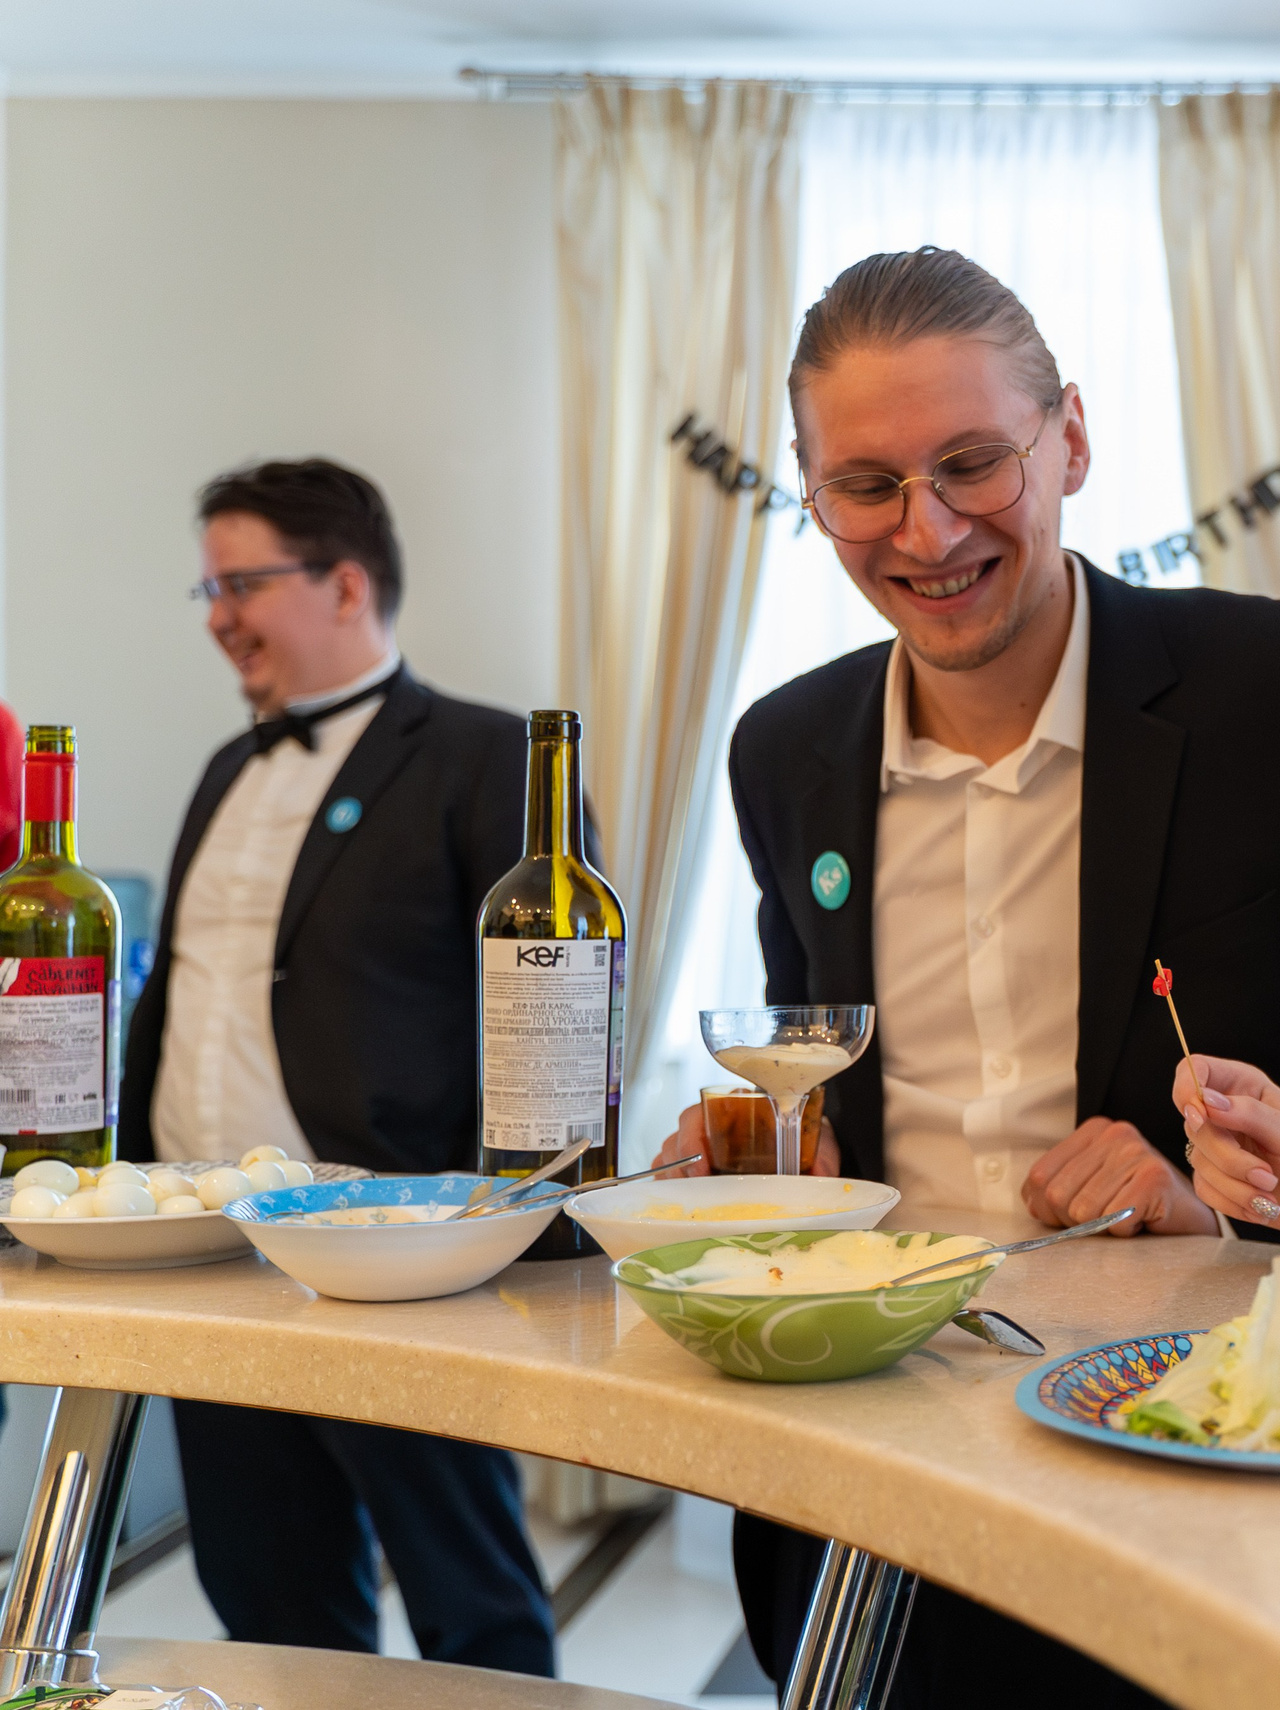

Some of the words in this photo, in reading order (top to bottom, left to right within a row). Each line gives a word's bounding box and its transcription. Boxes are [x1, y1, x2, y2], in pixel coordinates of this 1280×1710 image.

[512, 1002, 529, 1010] КЕФ
[529, 1001, 546, 1010] БАЙ
[548, 1002, 575, 1010] КАРАС
[502, 1008, 556, 1018] ОРДИНАРНОЕ
[557, 1009, 583, 1017] СУХОЕ
[532, 1017, 551, 1028] ГОД
[591, 1015, 607, 1025] 2022
